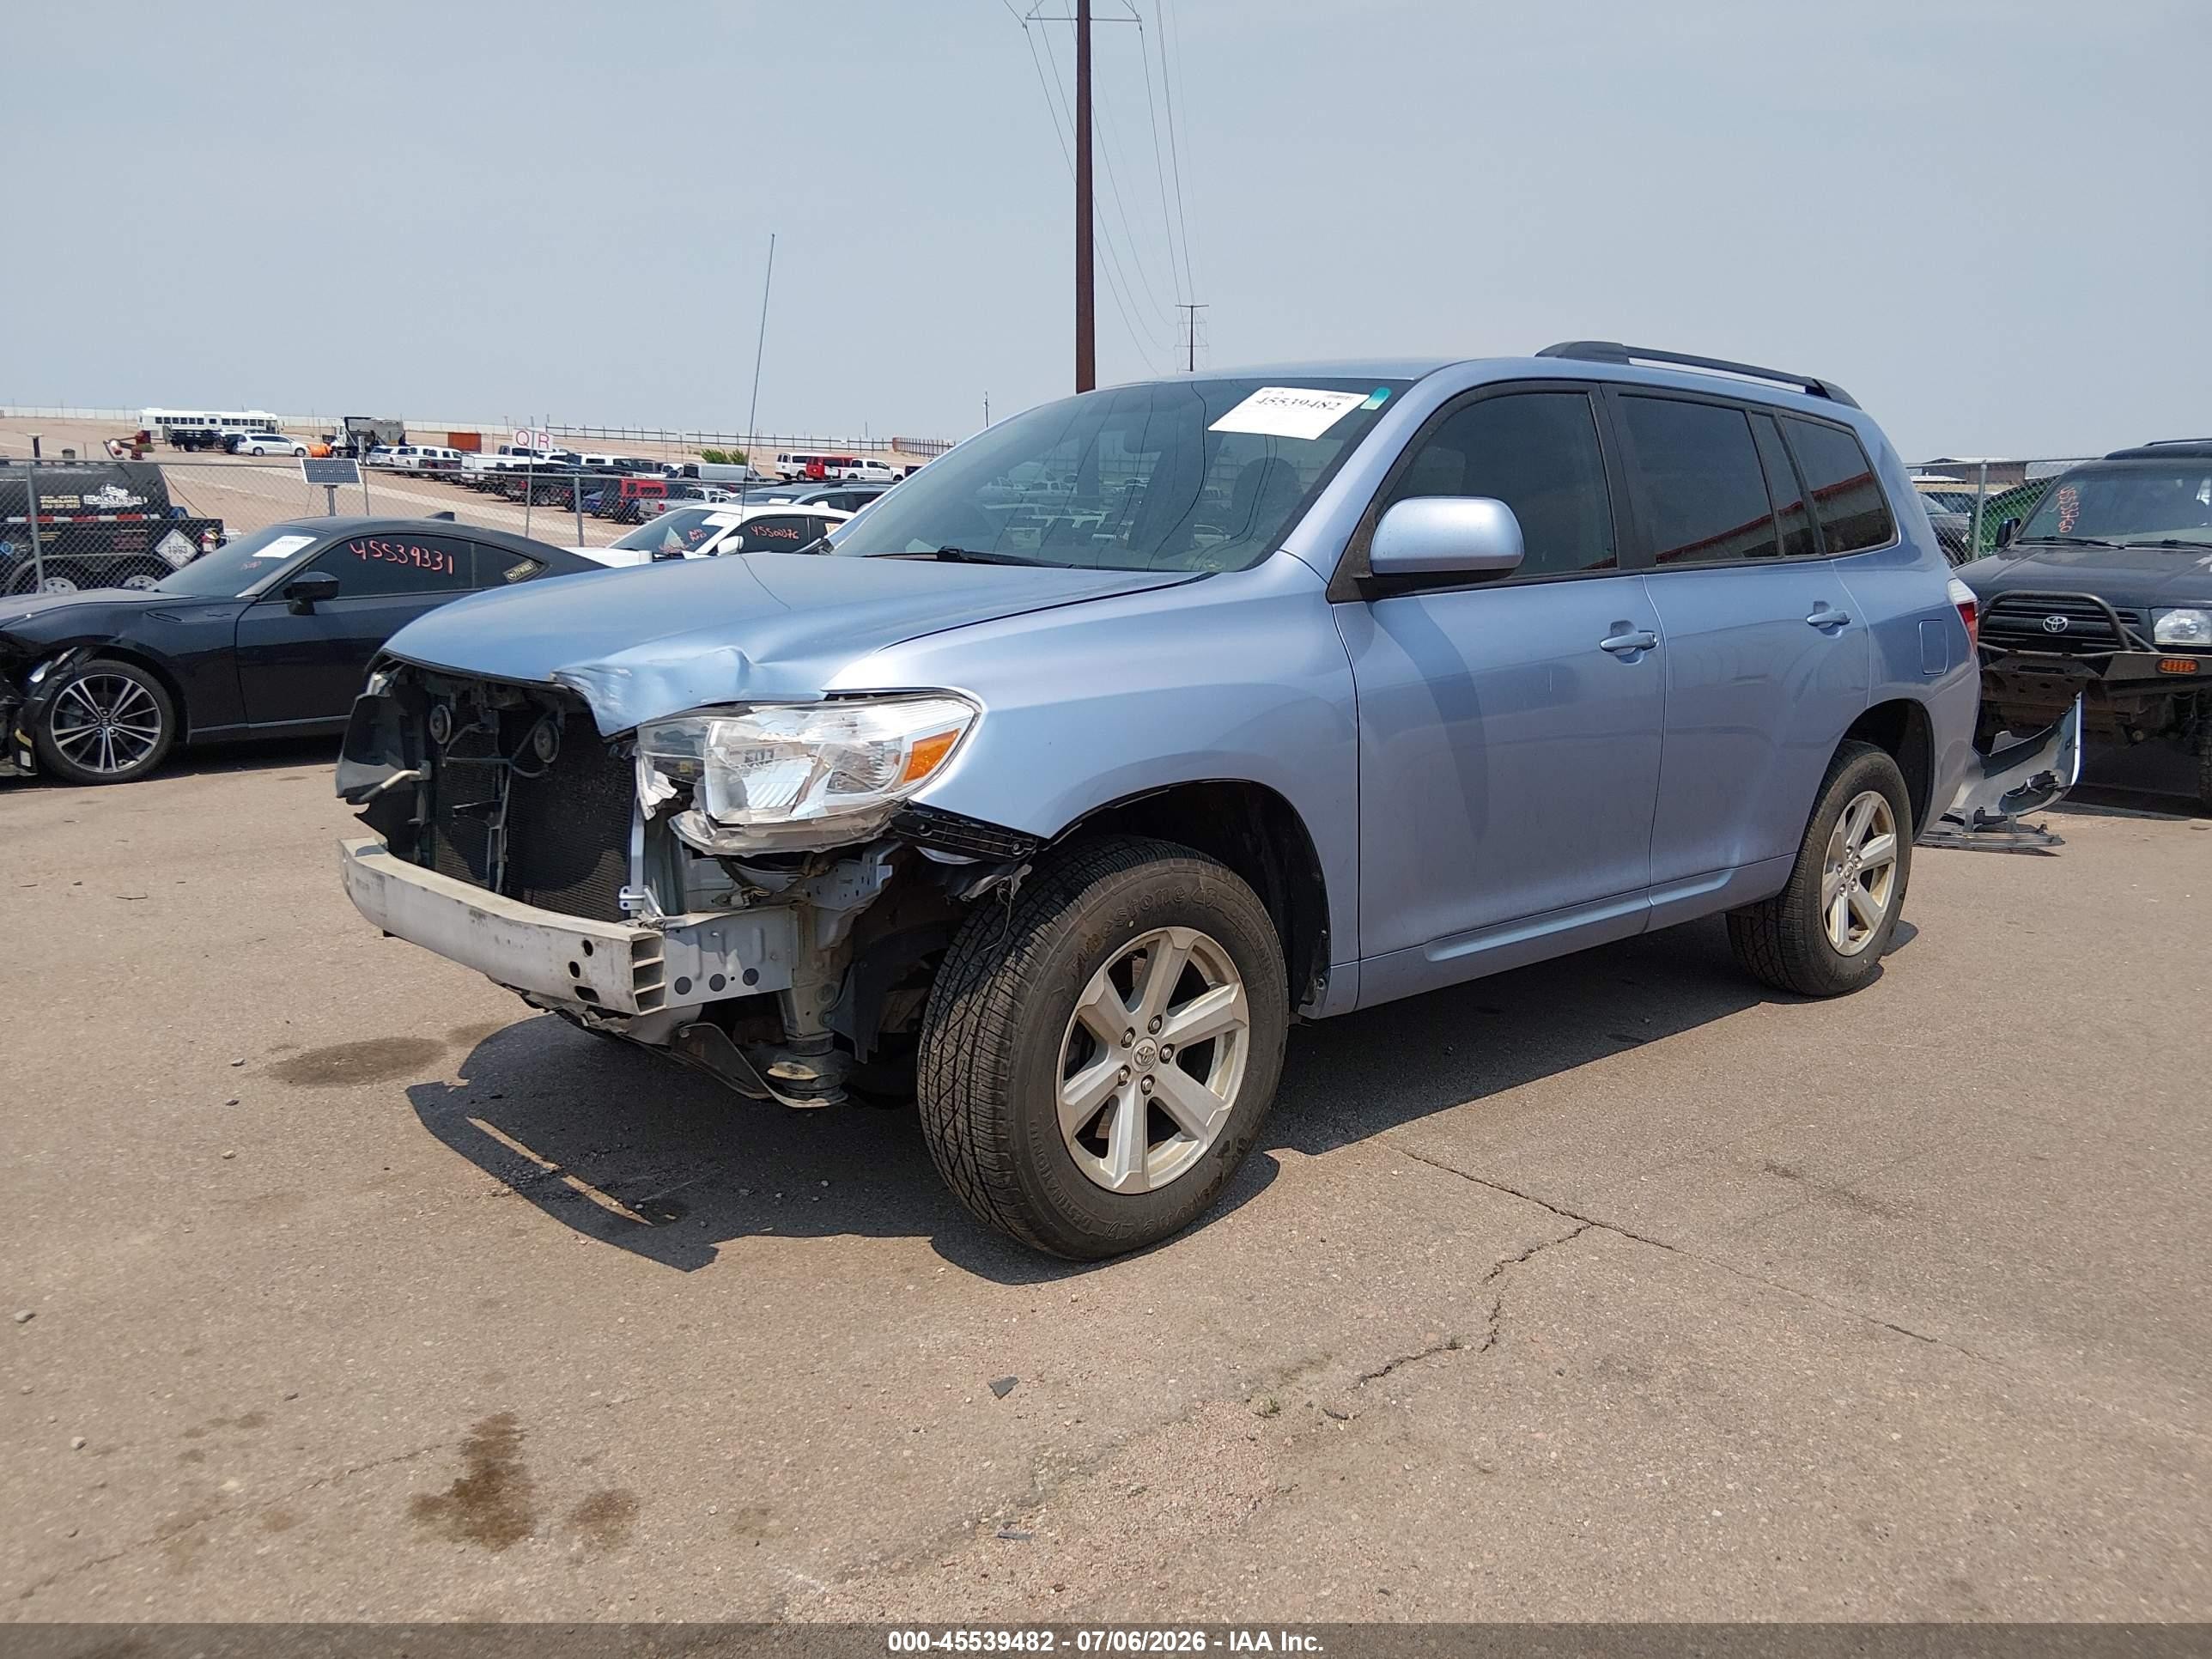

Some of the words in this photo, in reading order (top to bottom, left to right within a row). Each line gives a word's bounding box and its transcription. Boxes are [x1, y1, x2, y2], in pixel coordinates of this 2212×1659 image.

[1255, 396, 1343, 410] 45539482
[515, 430, 530, 447] Q
[538, 433, 550, 450] R
[349, 538, 453, 574] 45539331
